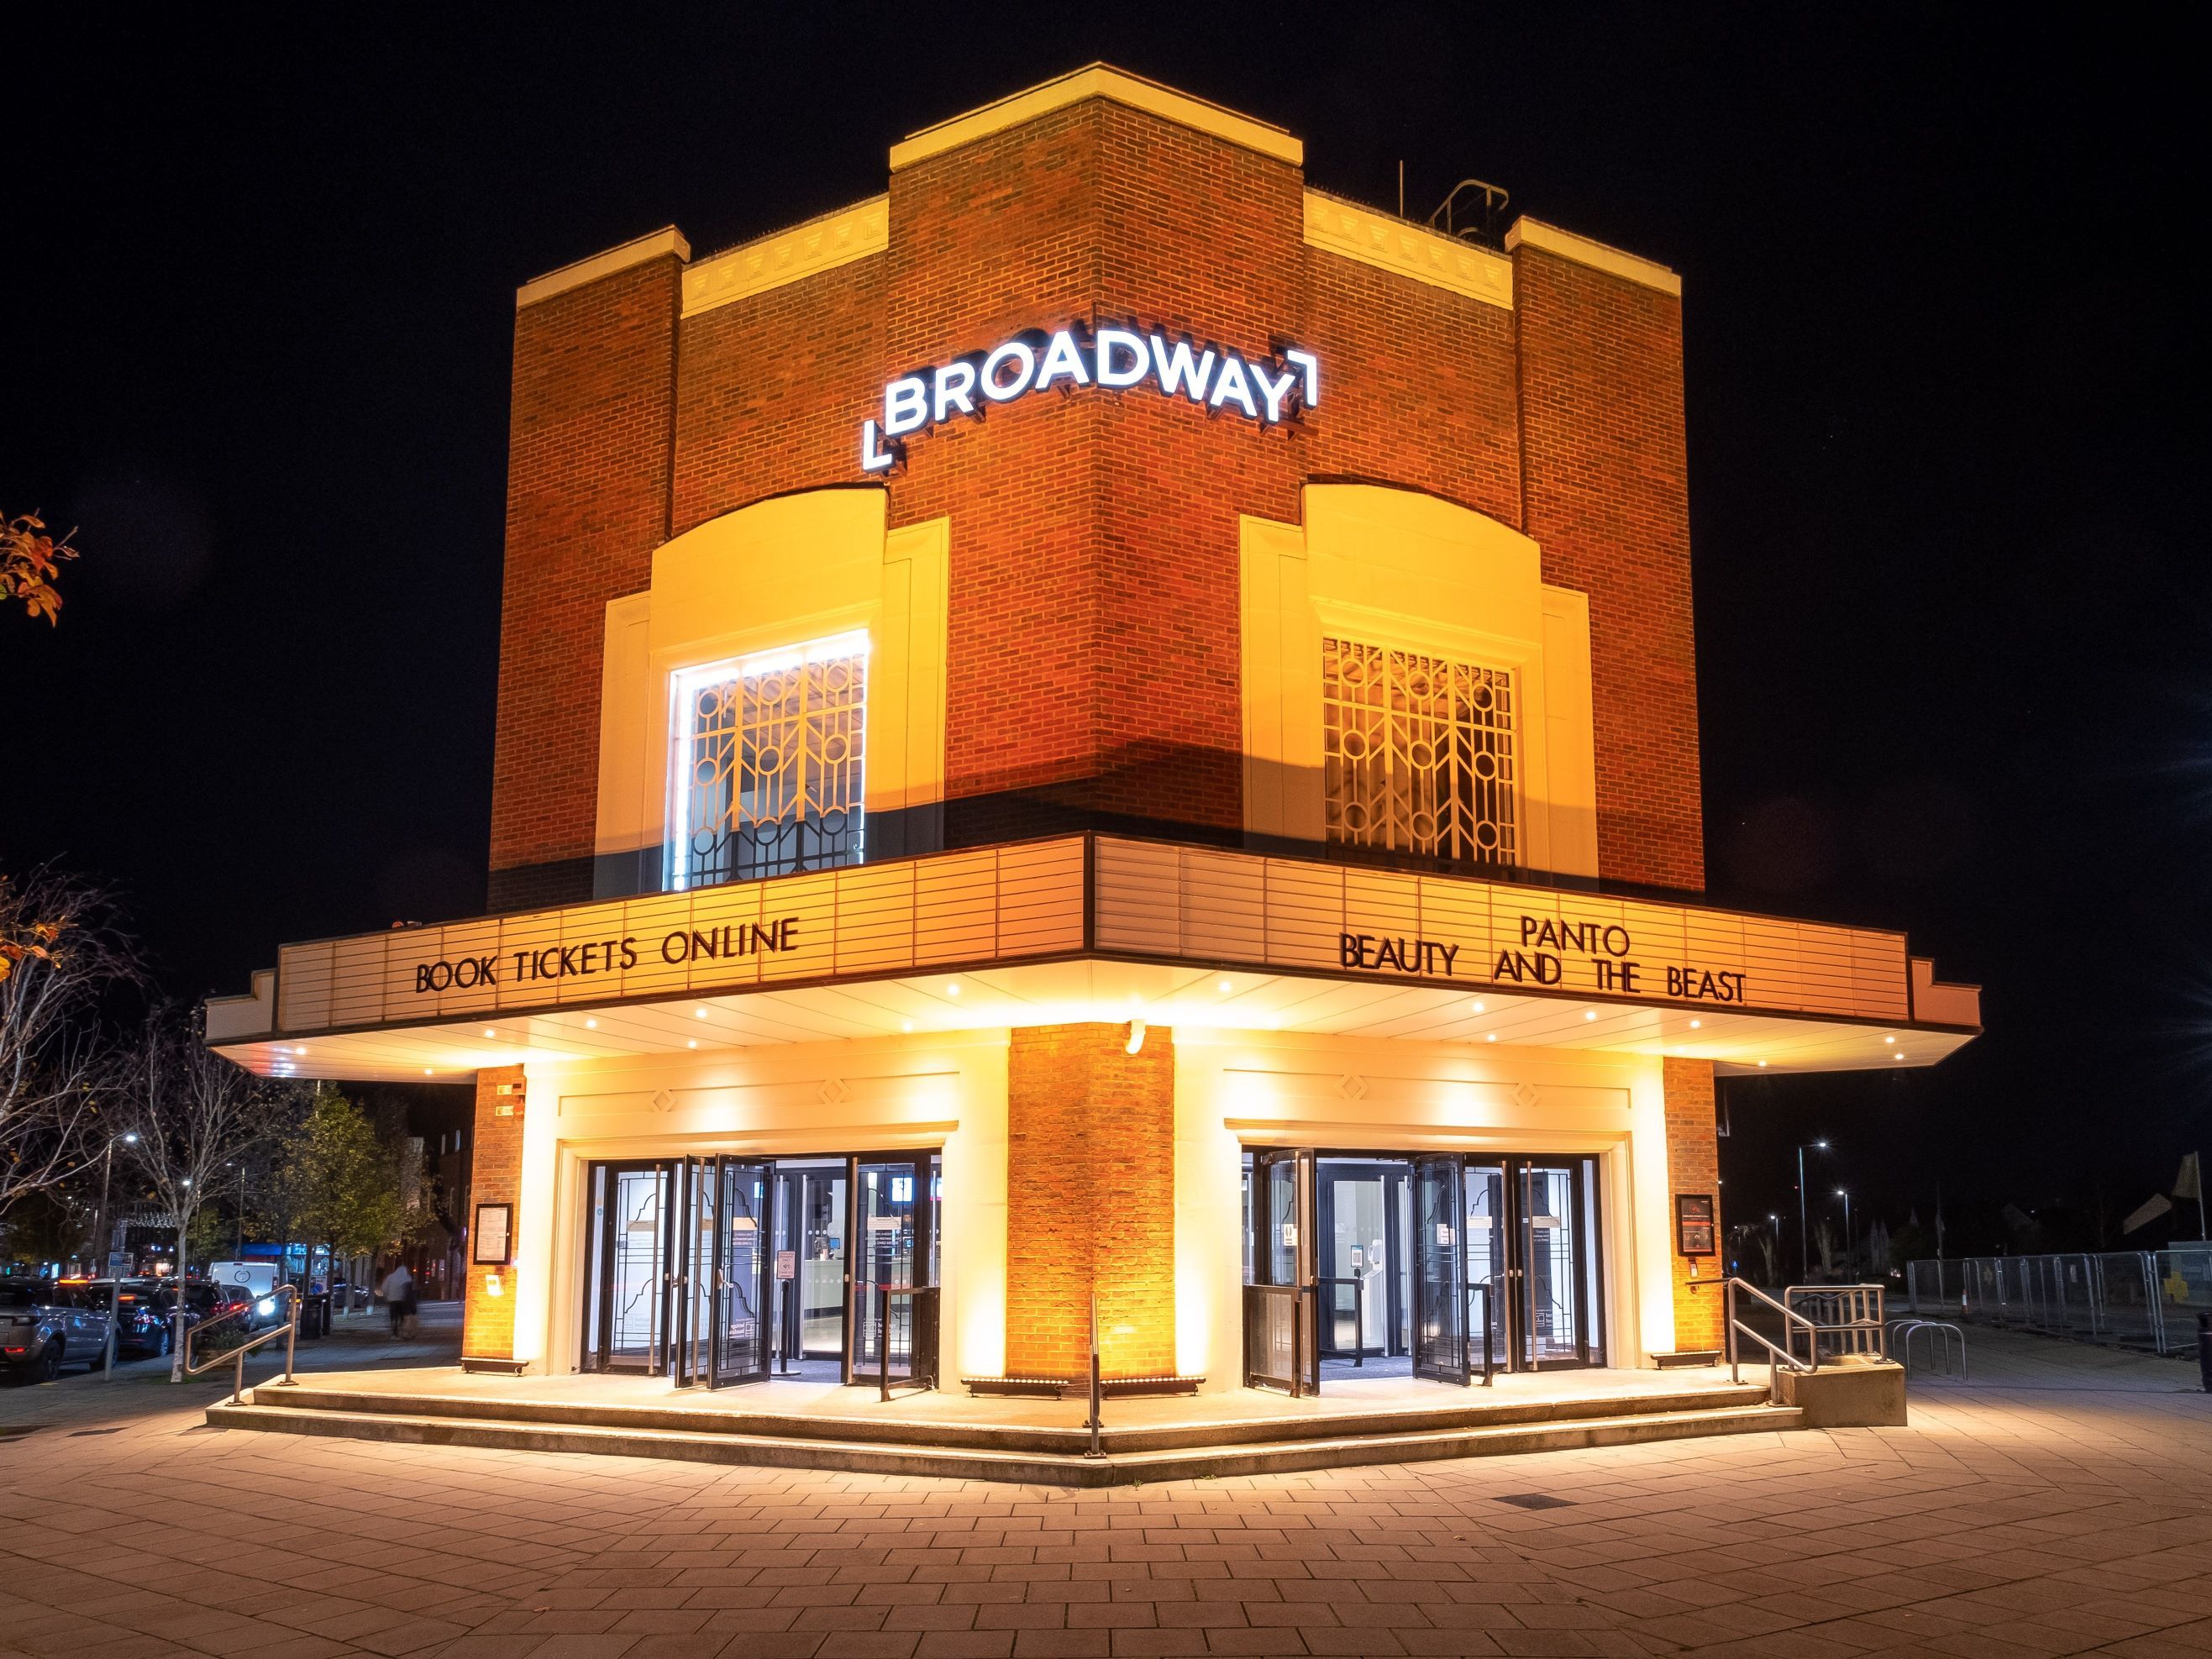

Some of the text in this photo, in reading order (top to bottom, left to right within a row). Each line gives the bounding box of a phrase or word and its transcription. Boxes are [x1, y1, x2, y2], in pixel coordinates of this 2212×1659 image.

[885, 329, 1296, 437] BROADWAY
[416, 917, 800, 994] BOOK TICKETS ONLINE
[1339, 932, 1747, 1003] BEAUTY AND THE BEAST
[1521, 916, 1630, 958] PANTO
